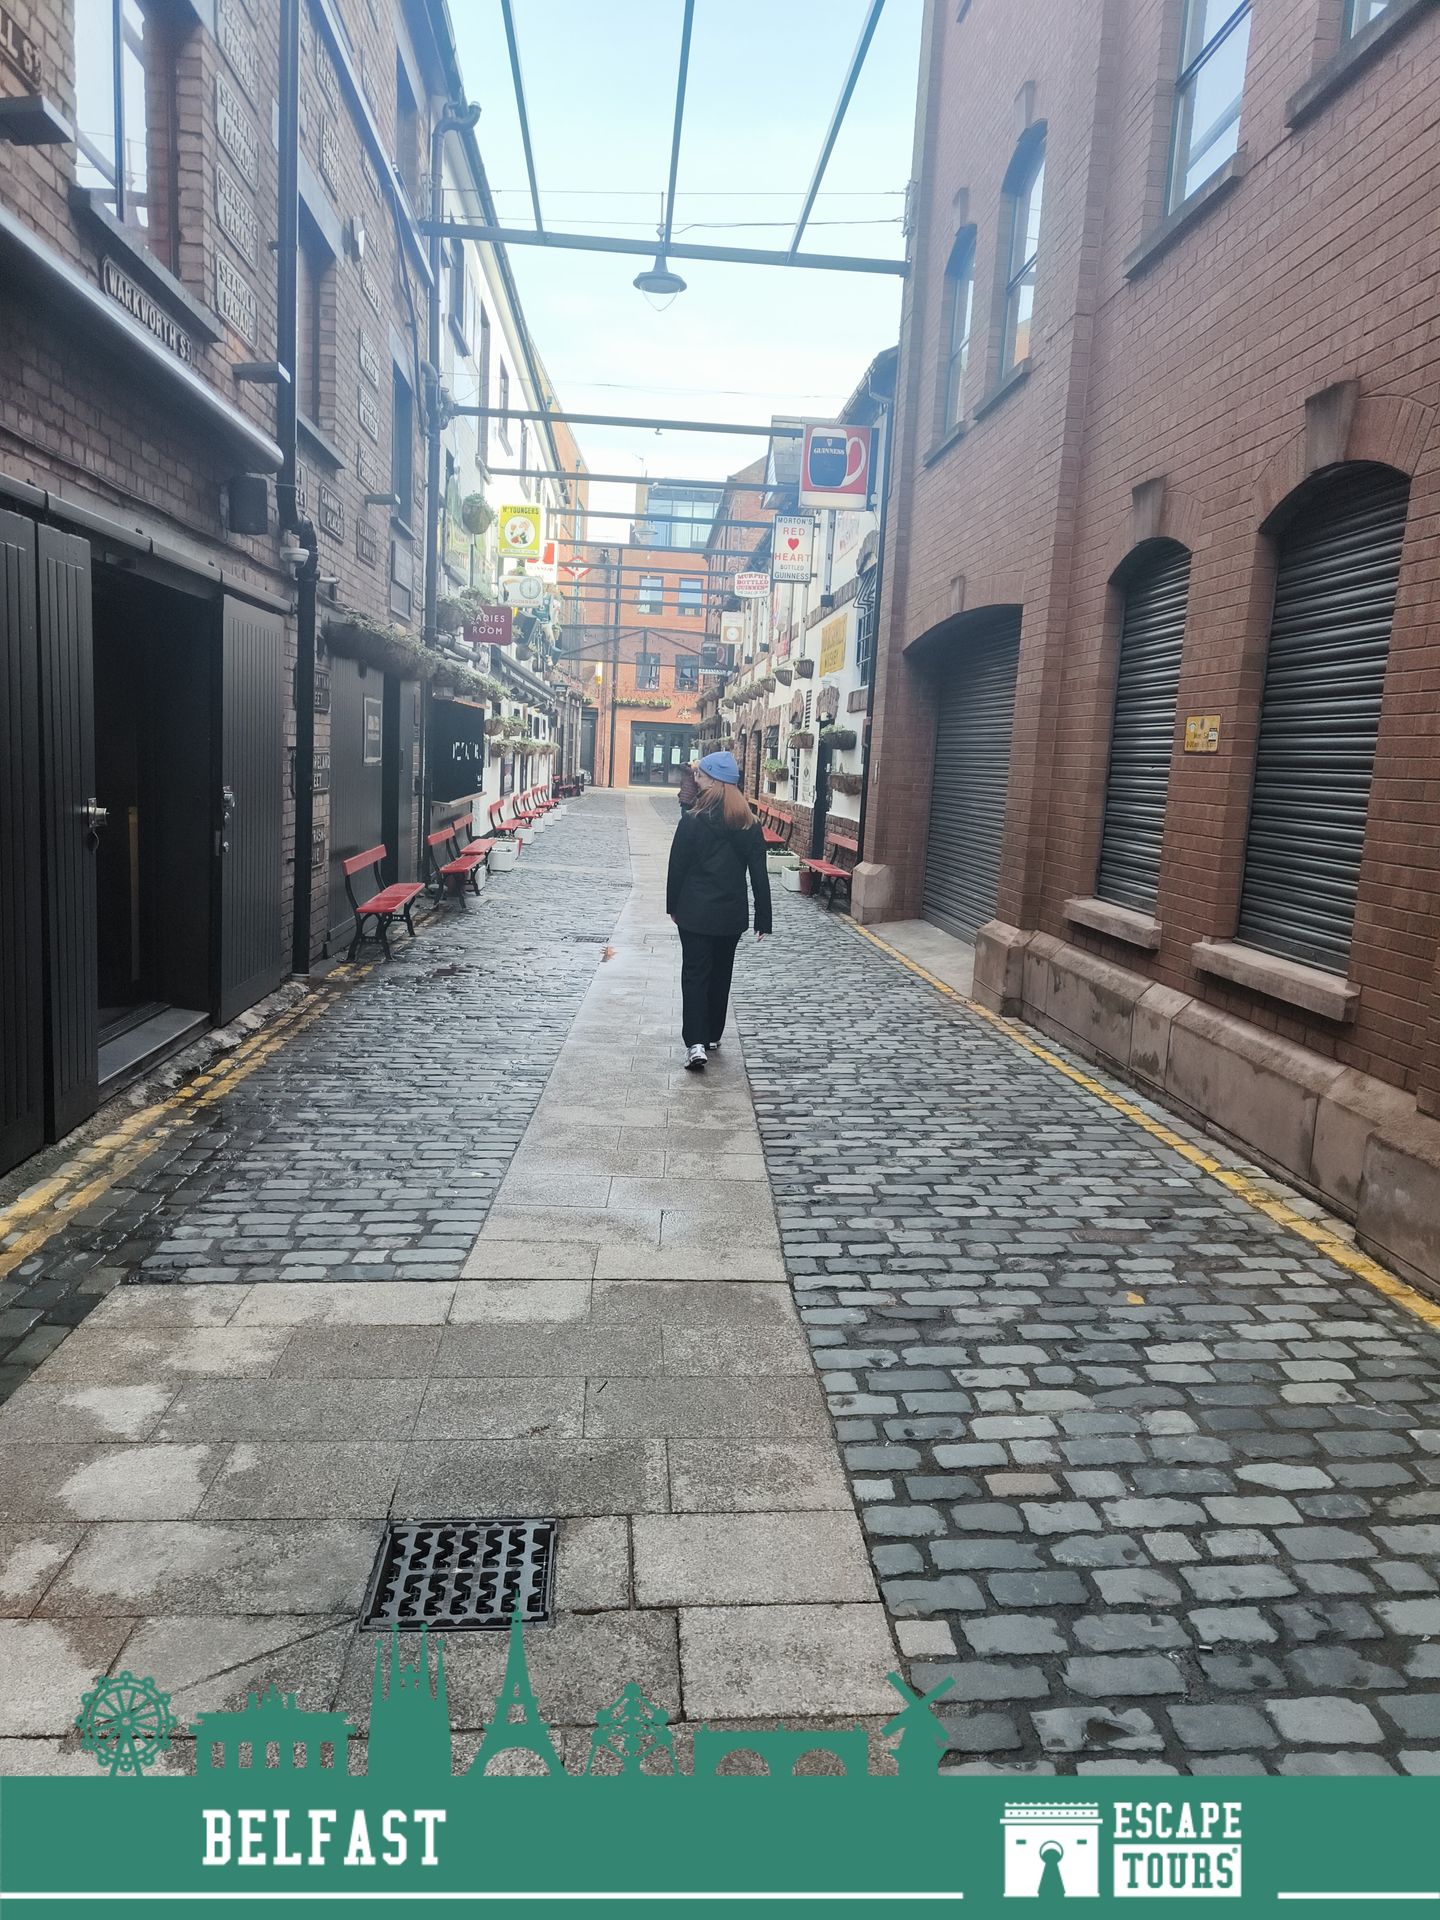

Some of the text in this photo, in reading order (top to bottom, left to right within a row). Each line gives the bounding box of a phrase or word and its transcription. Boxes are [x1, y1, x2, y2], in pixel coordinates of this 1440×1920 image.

[223, 115, 254, 180] PARADE
[219, 169, 257, 241] SEASCAPE
[223, 204, 254, 261] PARADE
[220, 260, 257, 320] SEAHOLM
[109, 266, 177, 351] WARKWORTH
[223, 291, 254, 341] PARADE
[813, 447, 846, 456] GUINNESS
[327, 511, 342, 535] PLACE
[777, 517, 813, 526] MORTON'S
[783, 527, 805, 536] RED
[775, 552, 811, 562] HEART
[774, 571, 810, 580] GUINNESS
[470, 614, 505, 623] ADIES
[472, 626, 503, 635] ROOM
